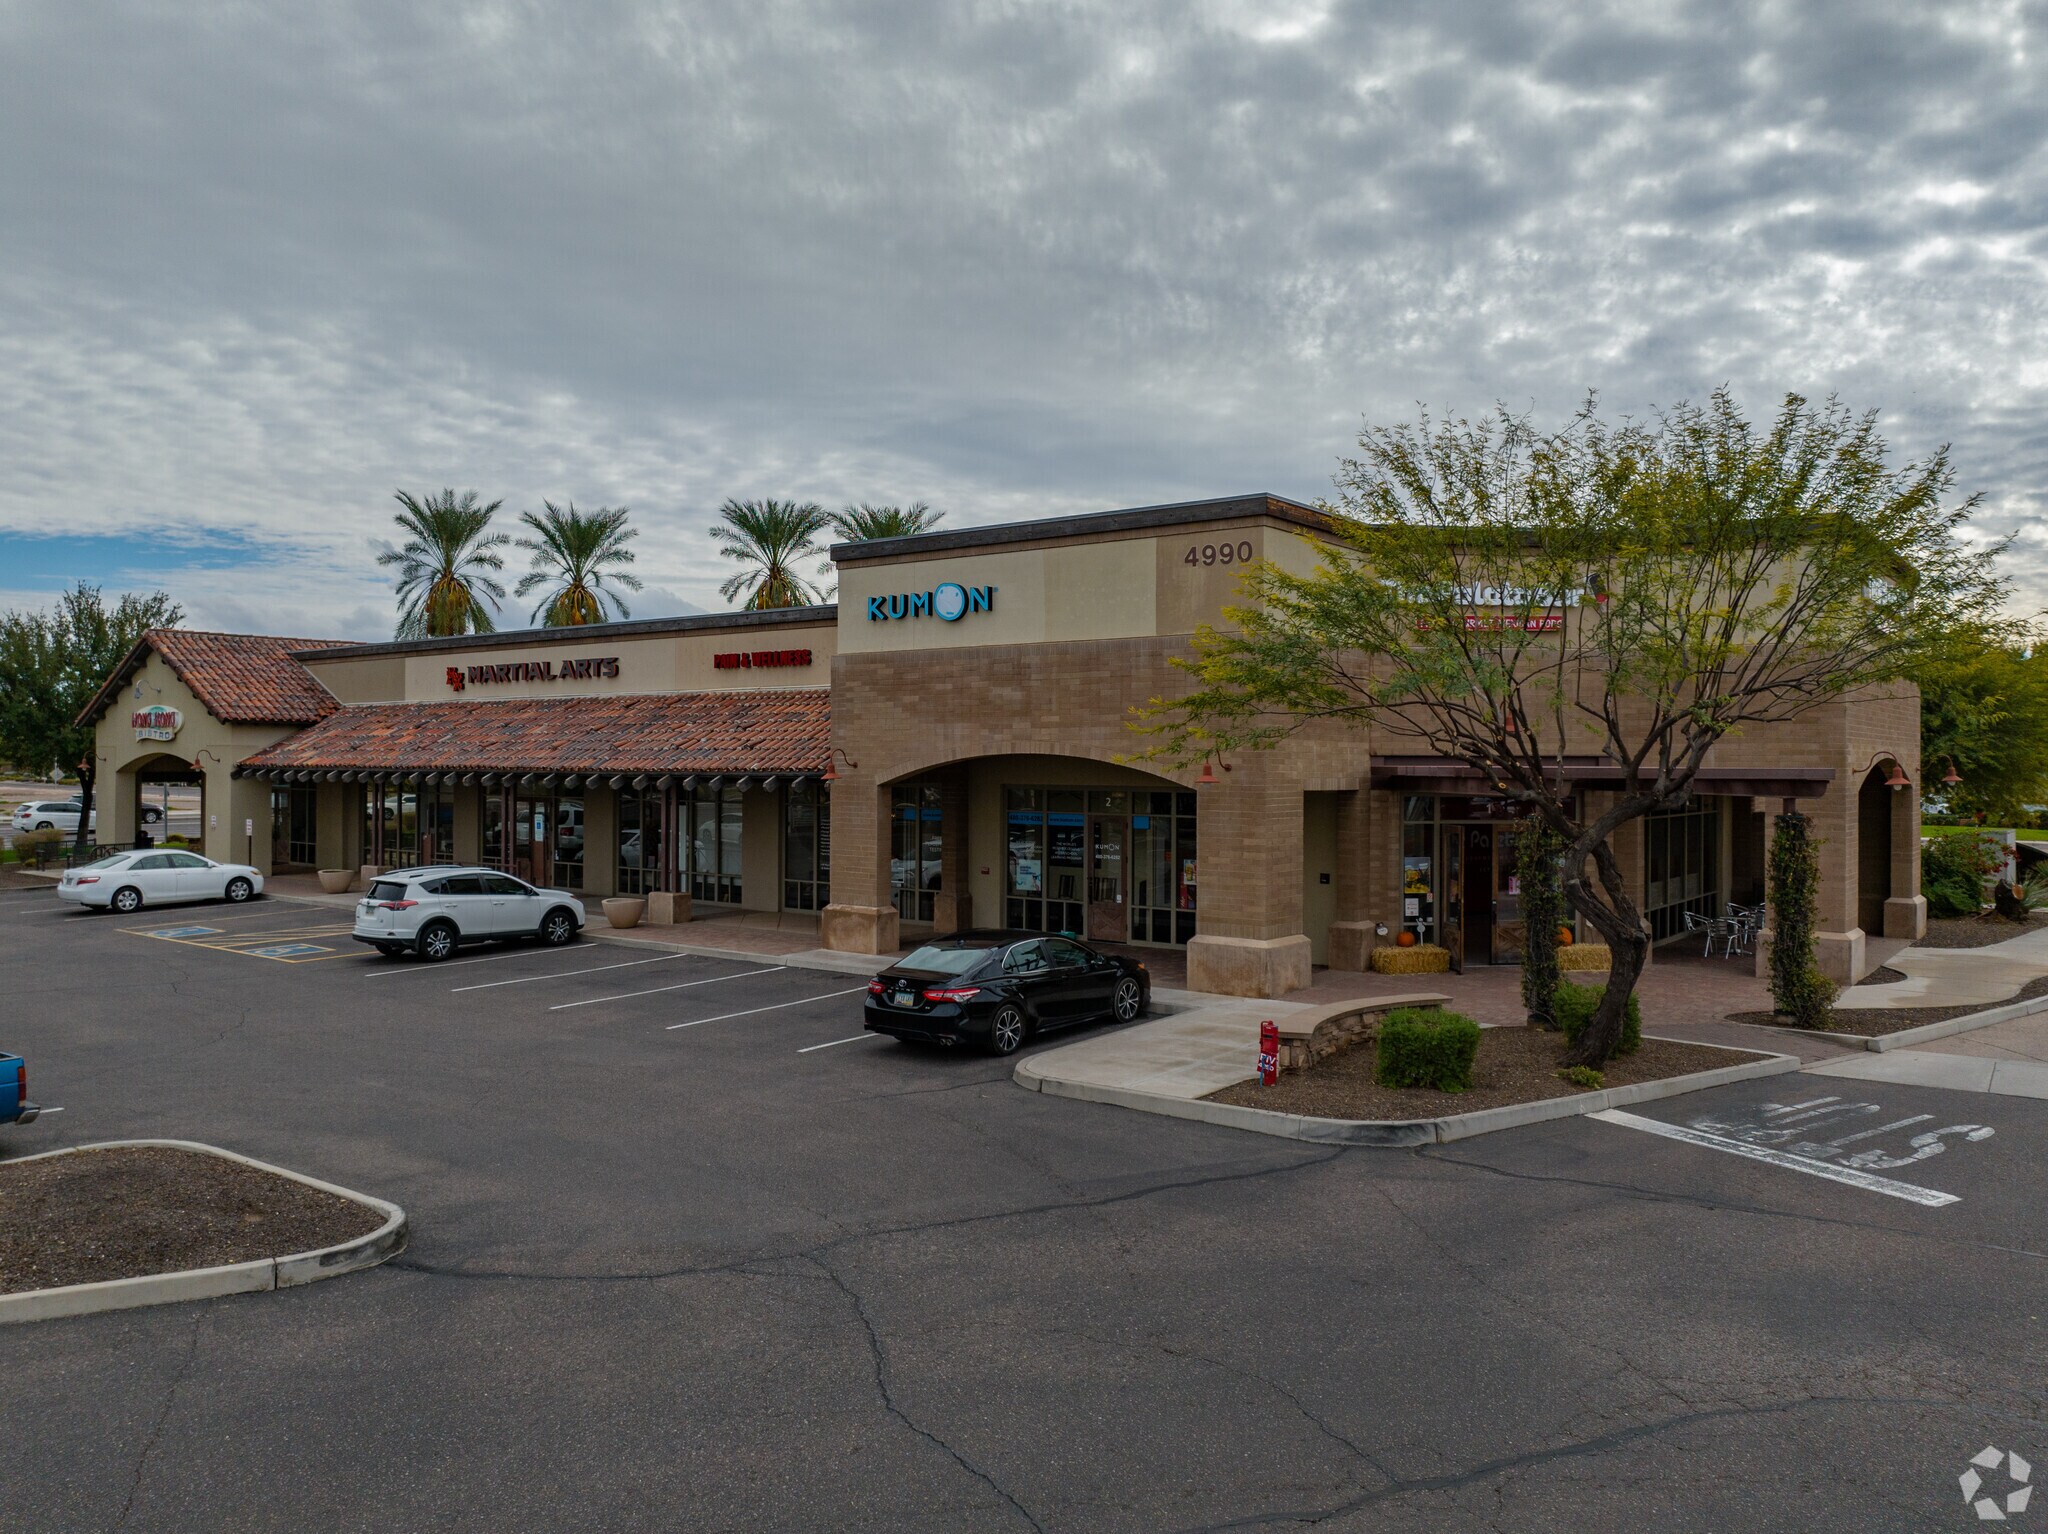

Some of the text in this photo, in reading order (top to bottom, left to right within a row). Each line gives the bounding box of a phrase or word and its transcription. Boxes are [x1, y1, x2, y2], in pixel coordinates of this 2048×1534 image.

[1184, 541, 1252, 567] 4990
[868, 583, 993, 621] KUMON
[714, 650, 812, 669] PAIN & WELLNESS
[467, 661, 557, 684] MARTIAL
[558, 657, 619, 679] ARTS
[138, 730, 171, 740] BISTRO
[1105, 797, 1111, 807] 2
[1095, 843, 1120, 851] KUMON
